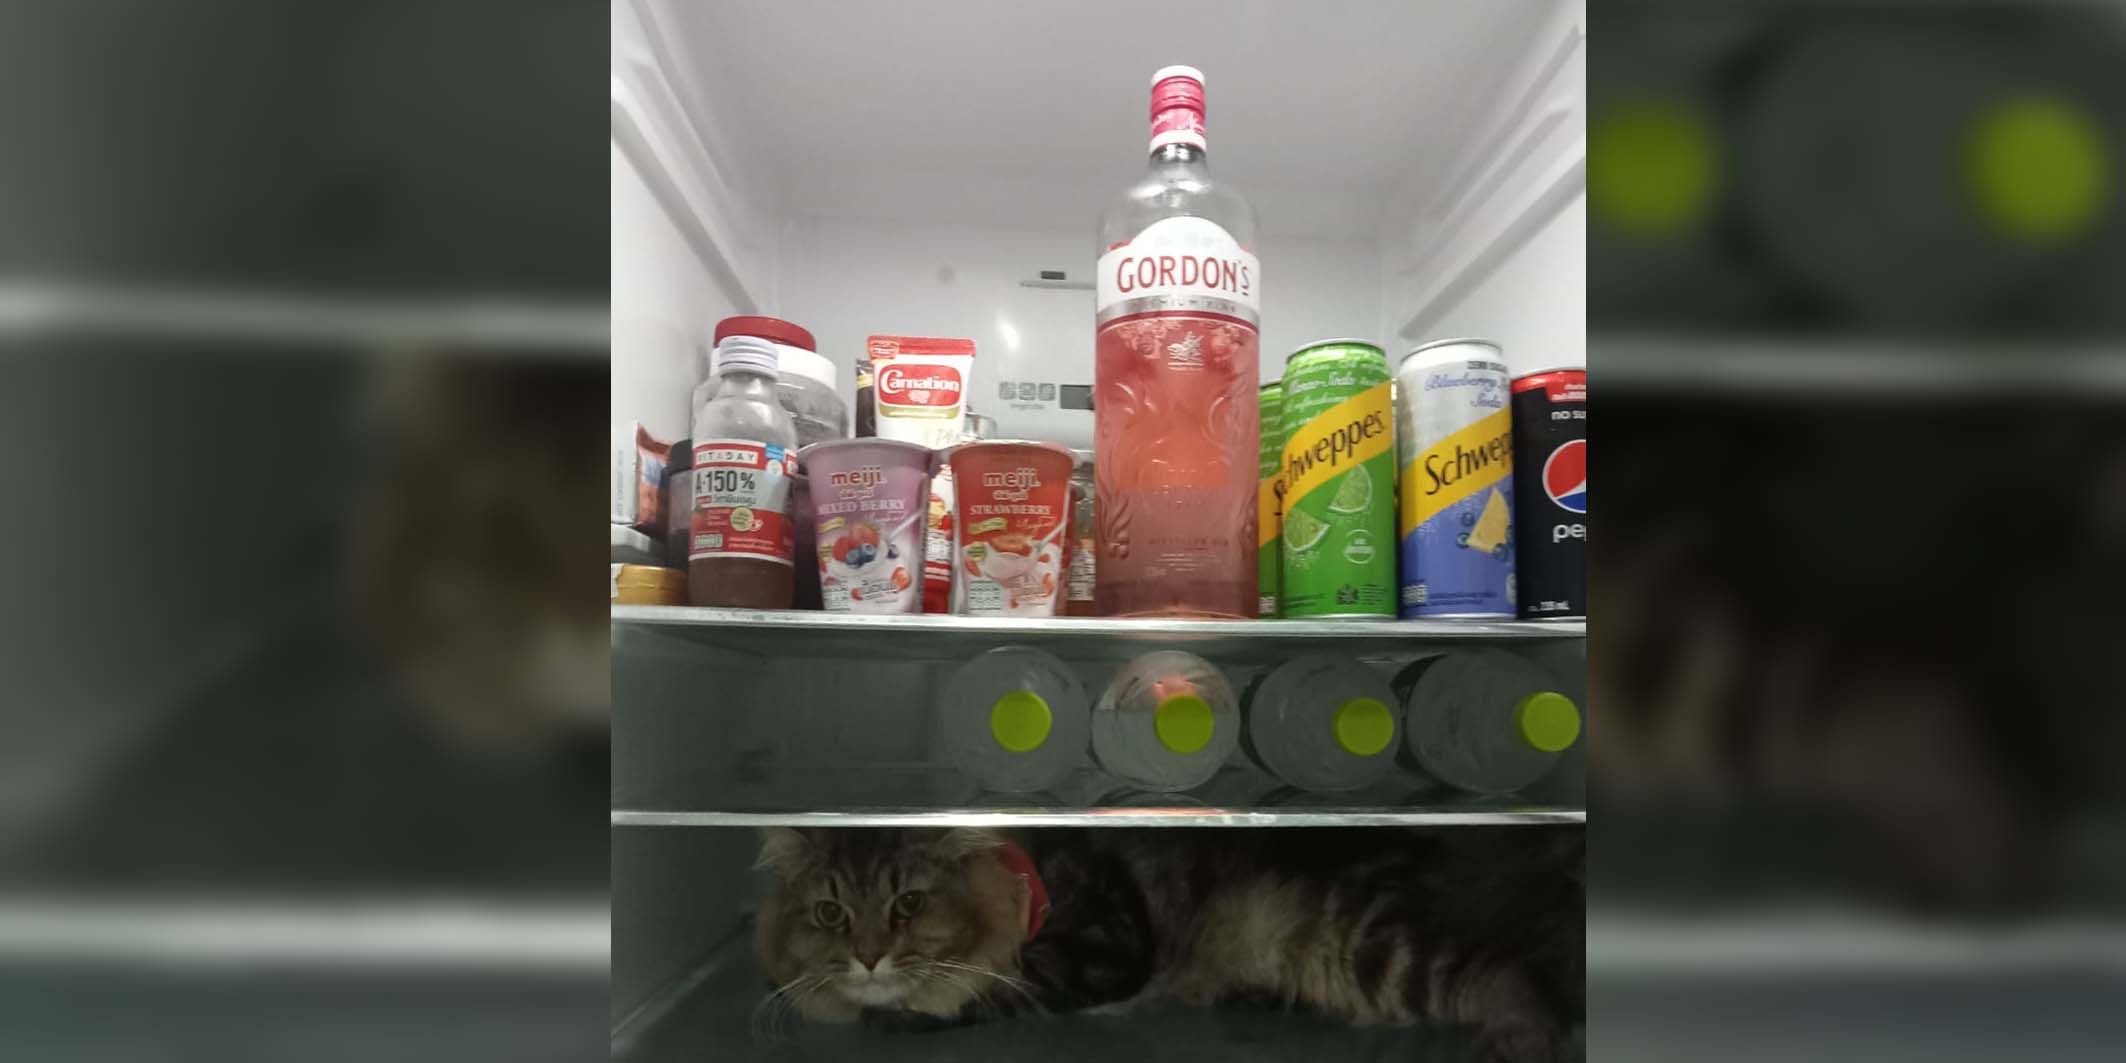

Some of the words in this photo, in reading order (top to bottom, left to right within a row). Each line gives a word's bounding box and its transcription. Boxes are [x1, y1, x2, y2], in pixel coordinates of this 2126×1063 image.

[1117, 255, 1249, 296] GORDON'S
[881, 370, 960, 394] Carnation
[831, 465, 881, 489] meiji
[983, 467, 1037, 491] meiji
